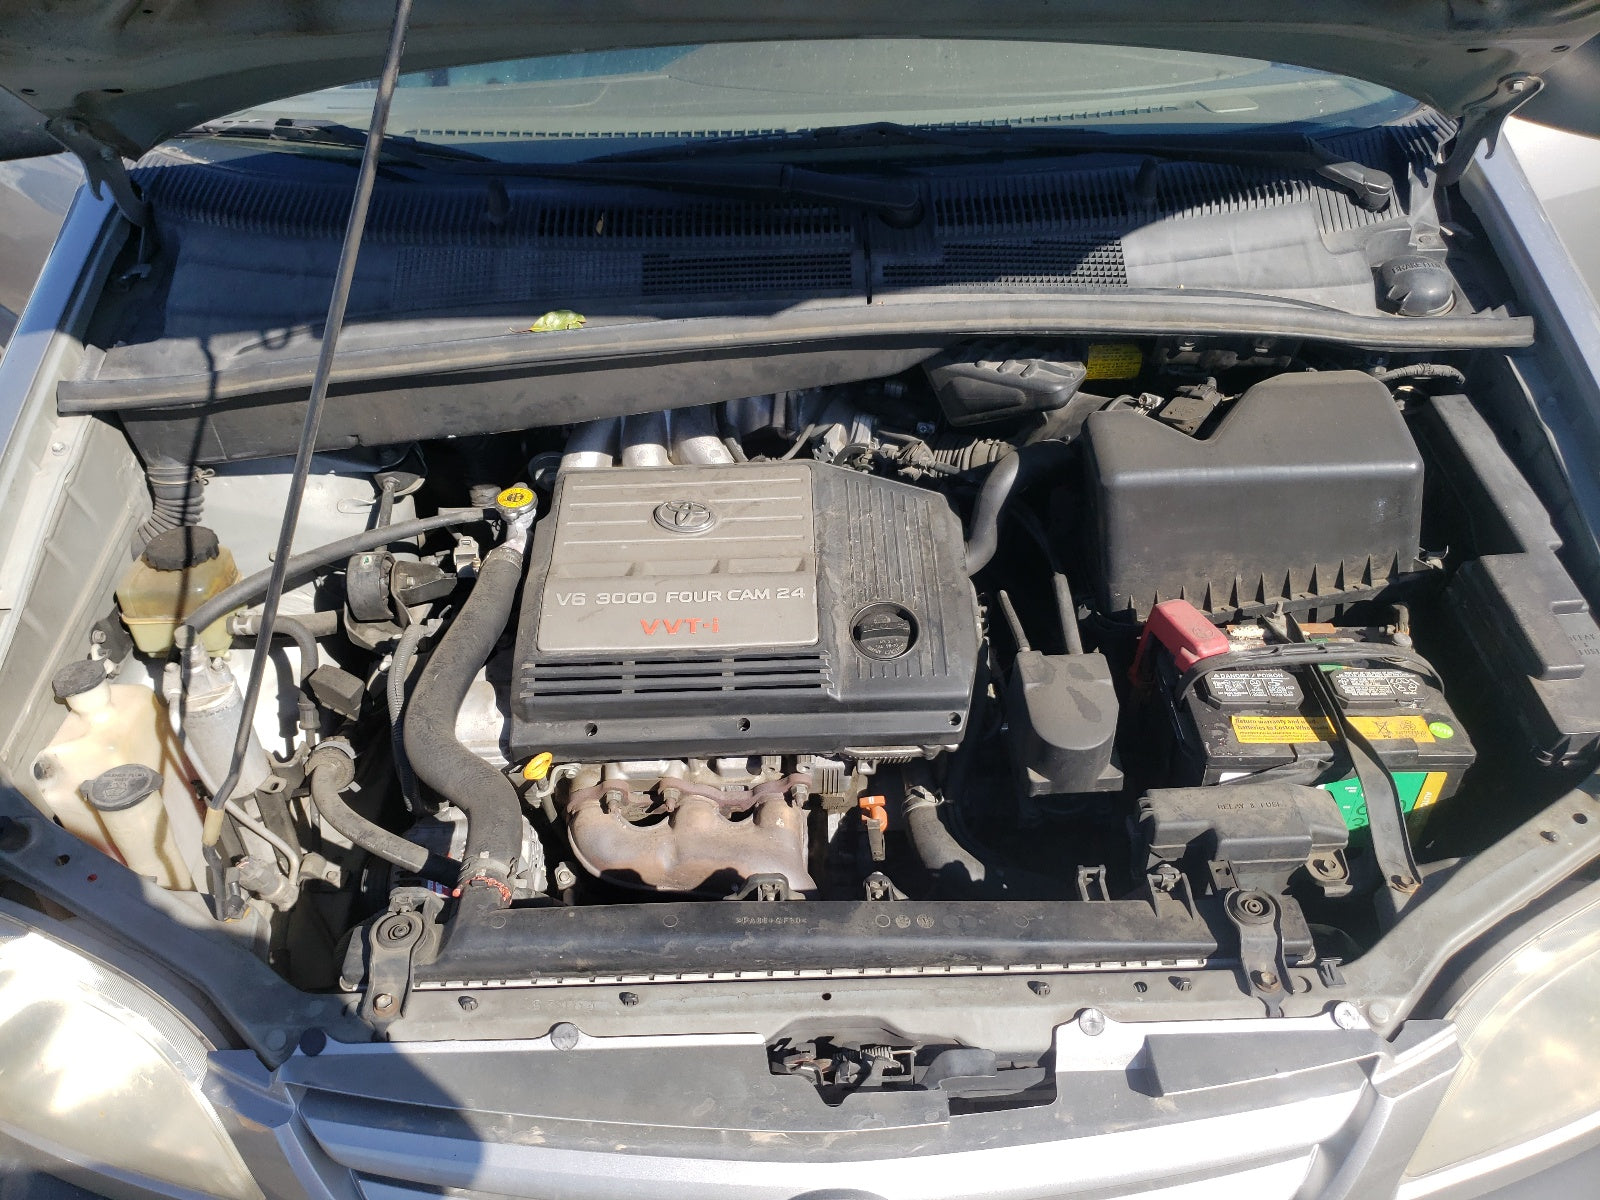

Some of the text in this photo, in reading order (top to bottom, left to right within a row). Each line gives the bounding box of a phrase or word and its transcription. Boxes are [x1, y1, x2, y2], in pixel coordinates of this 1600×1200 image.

[556, 587, 806, 606] V6 3000 FOUR CAM 24
[640, 617, 720, 635] VVT-i
